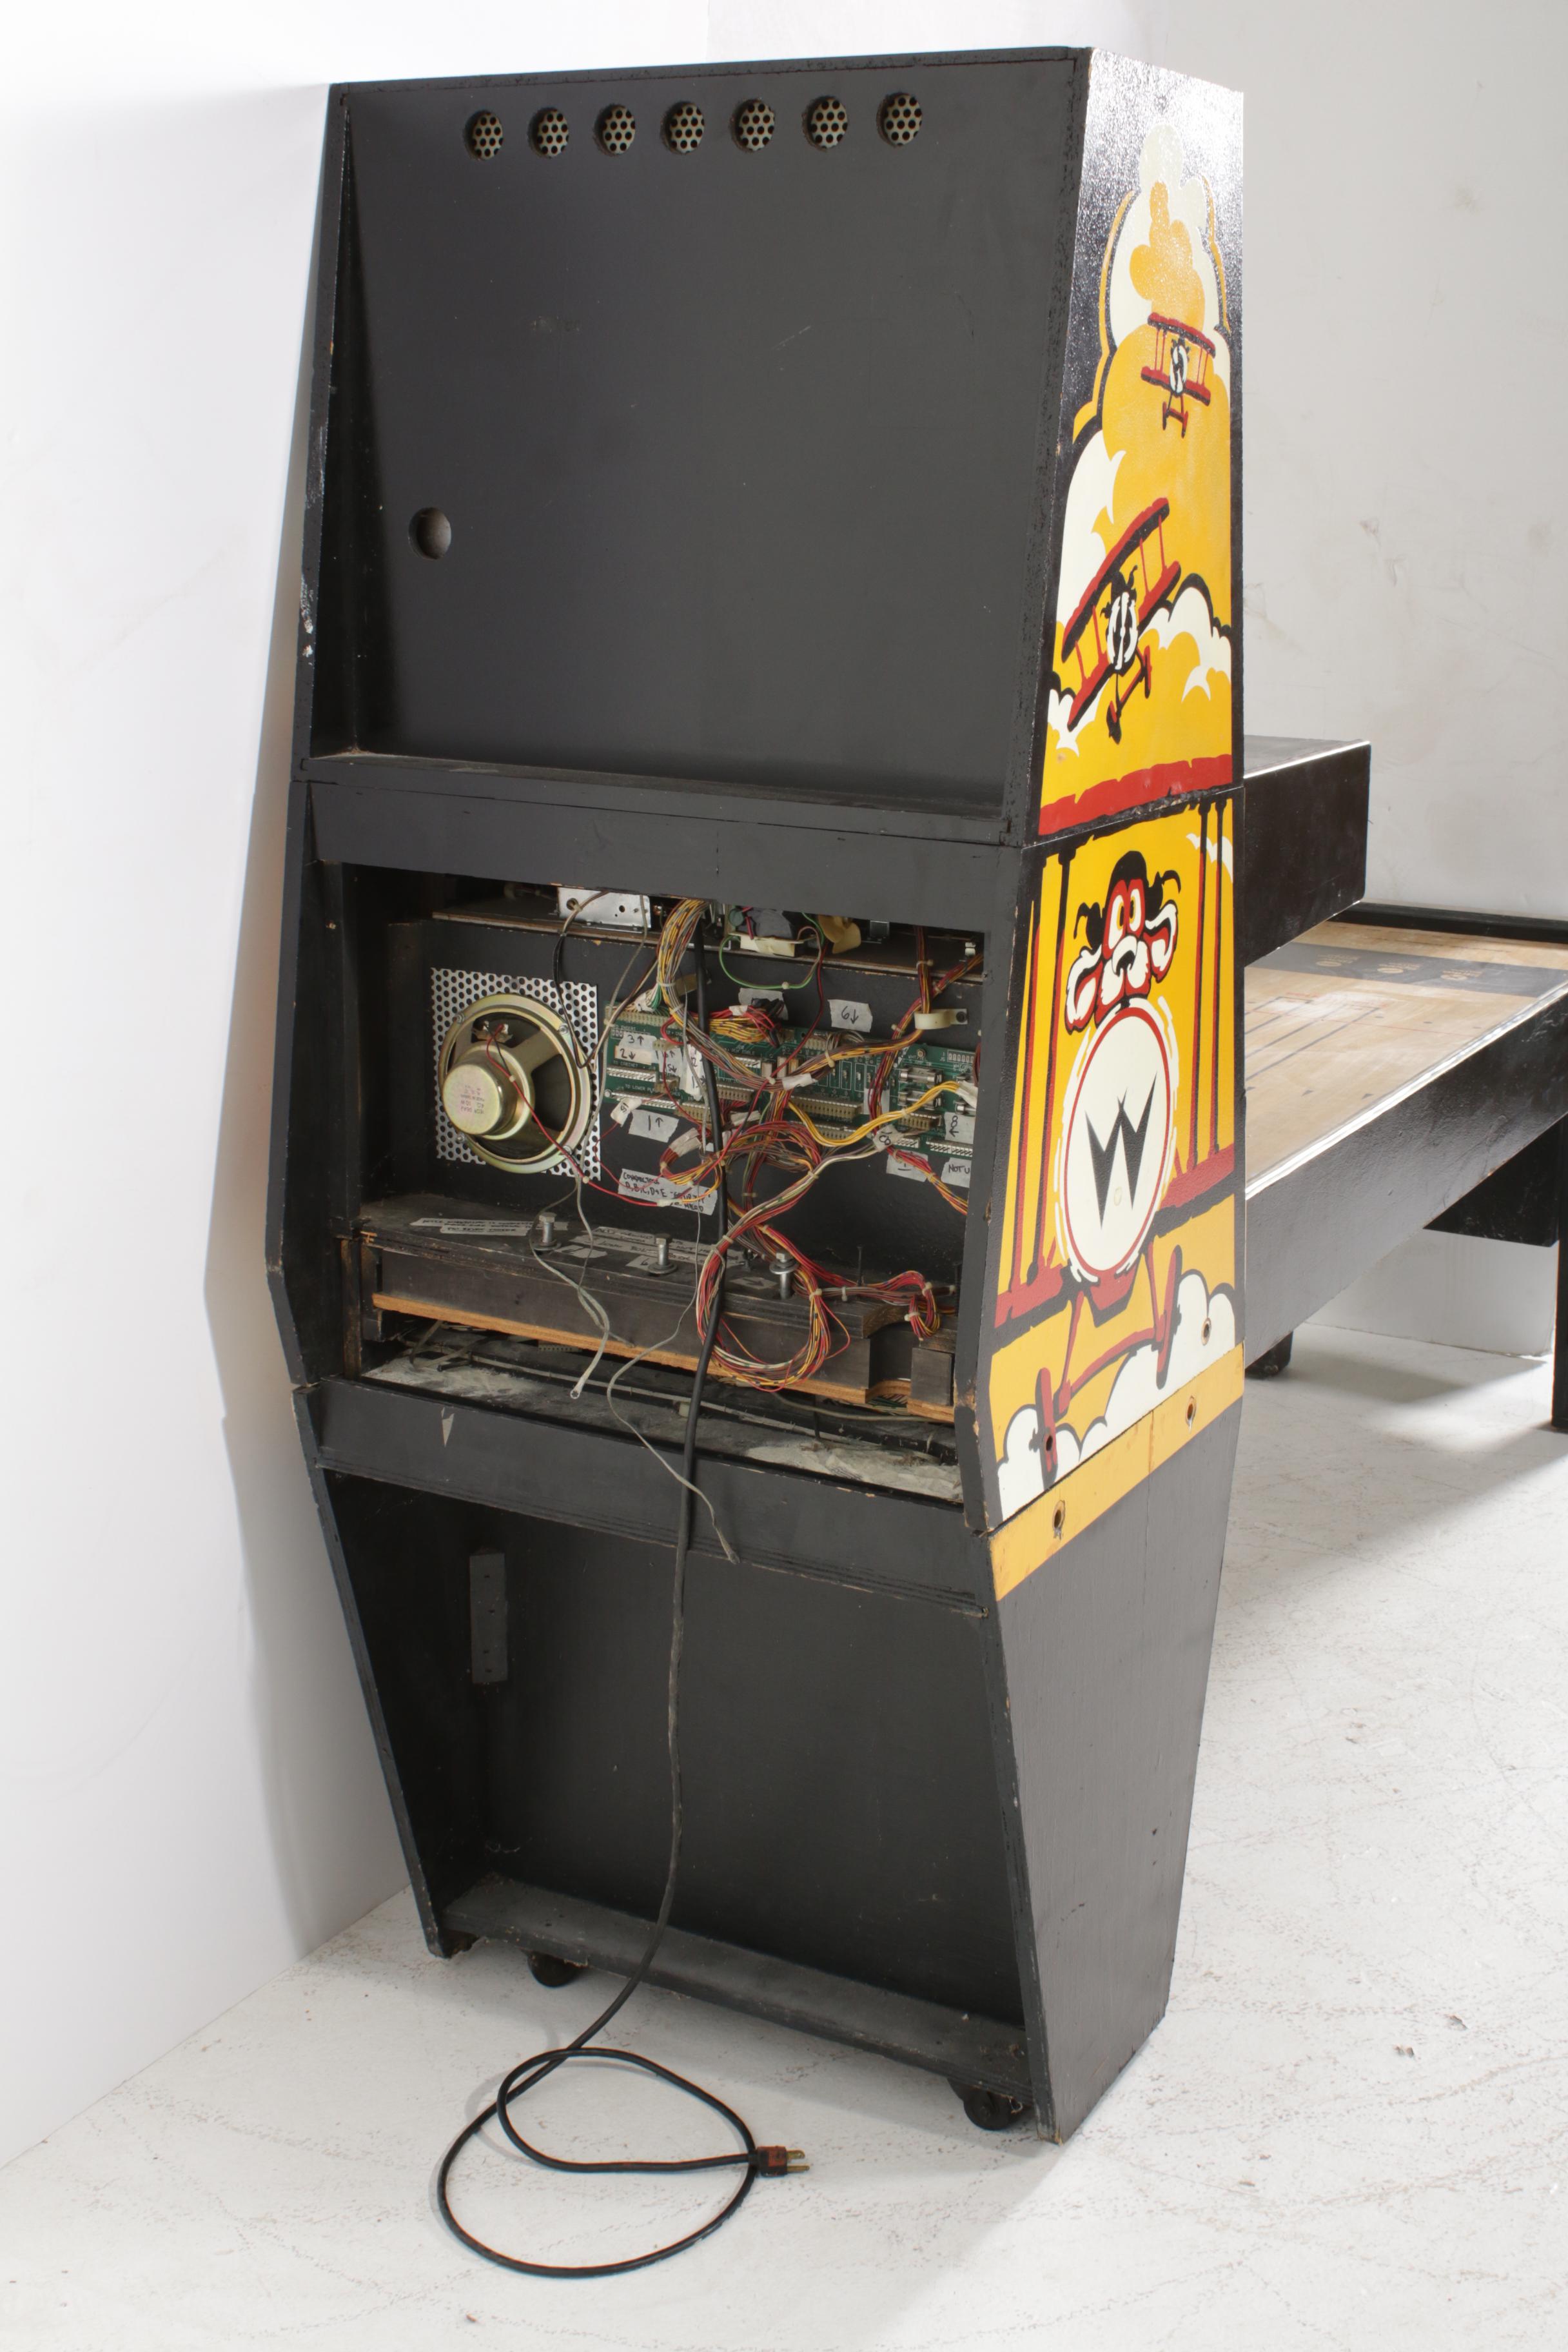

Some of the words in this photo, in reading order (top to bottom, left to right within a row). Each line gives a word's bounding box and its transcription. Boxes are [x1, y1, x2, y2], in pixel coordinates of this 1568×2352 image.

[841, 1006, 850, 1021] 6
[627, 1034, 635, 1044] 3
[620, 1048, 627, 1059] 2
[1084, 1072, 1157, 1230] W
[948, 1164, 962, 1173] NOT
